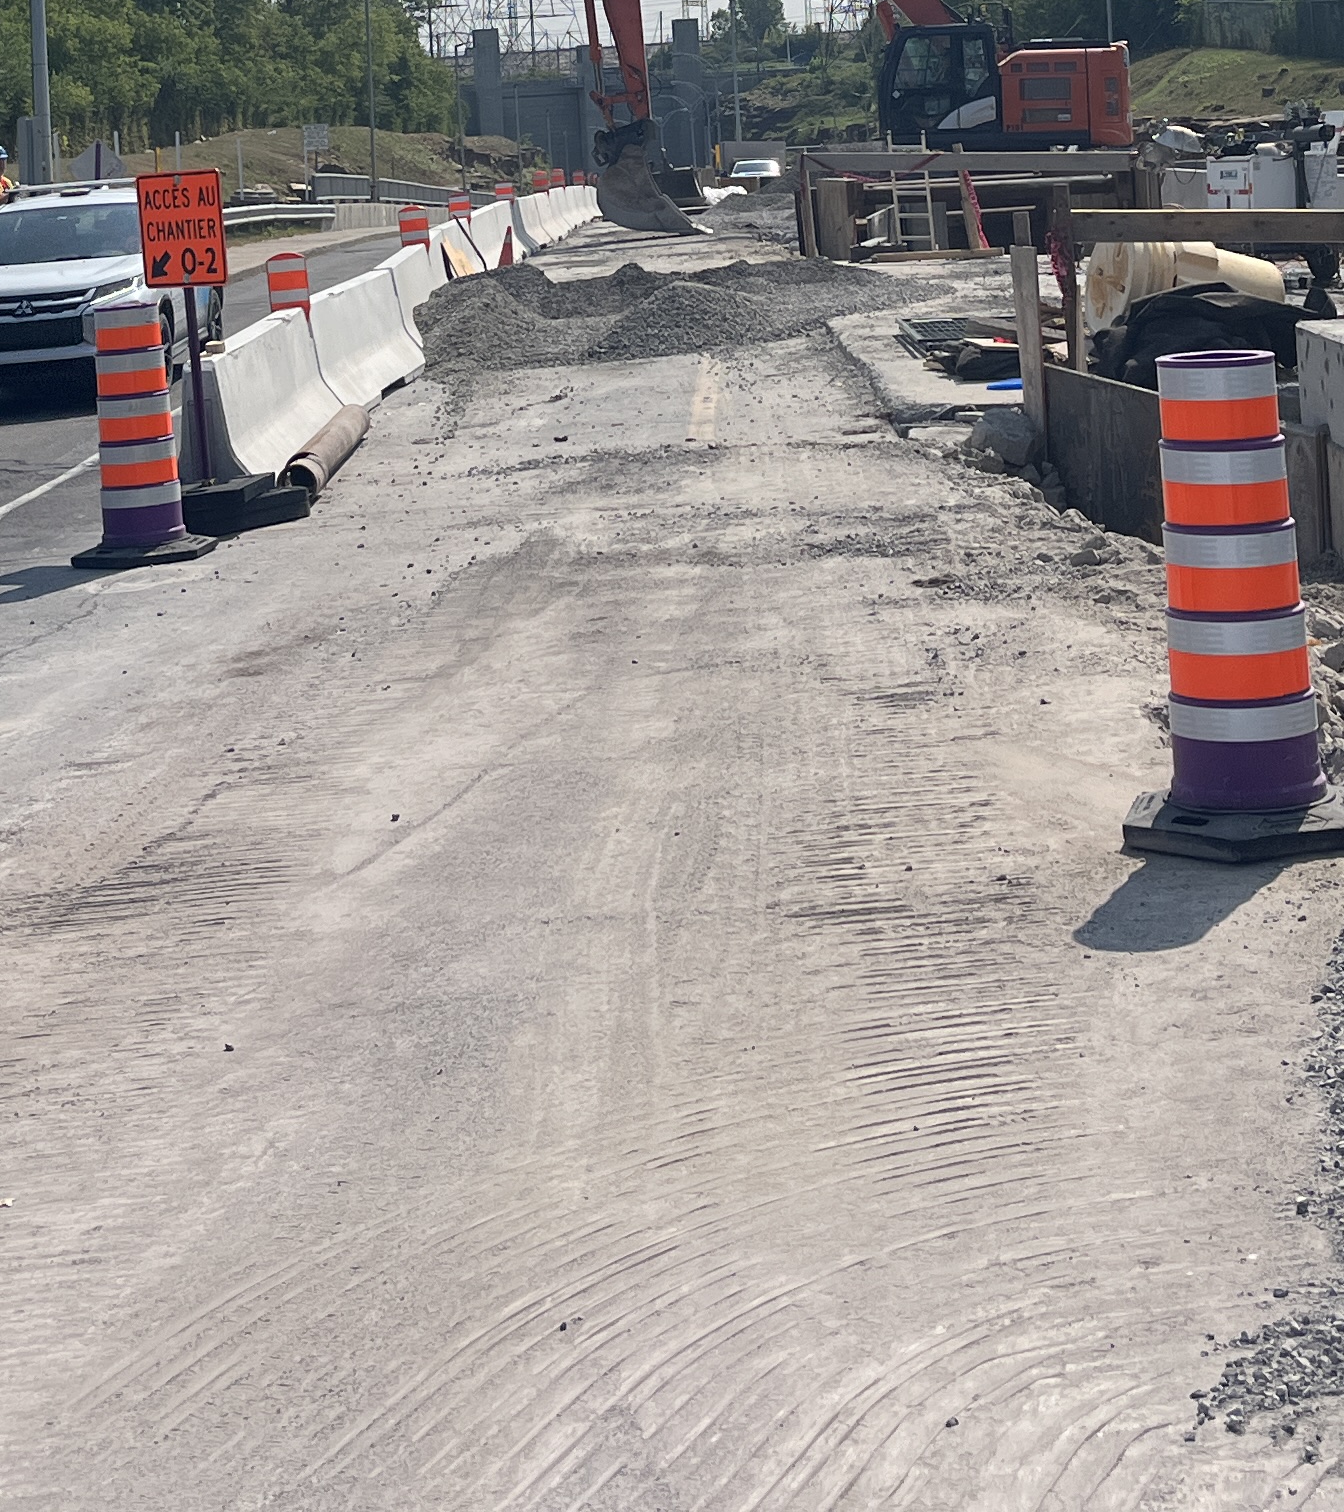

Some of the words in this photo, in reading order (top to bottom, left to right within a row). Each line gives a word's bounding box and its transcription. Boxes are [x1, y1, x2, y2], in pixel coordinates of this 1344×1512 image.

[144, 184, 190, 210] ACCÈS
[197, 186, 216, 207] AU
[147, 218, 217, 242] CHANTIER
